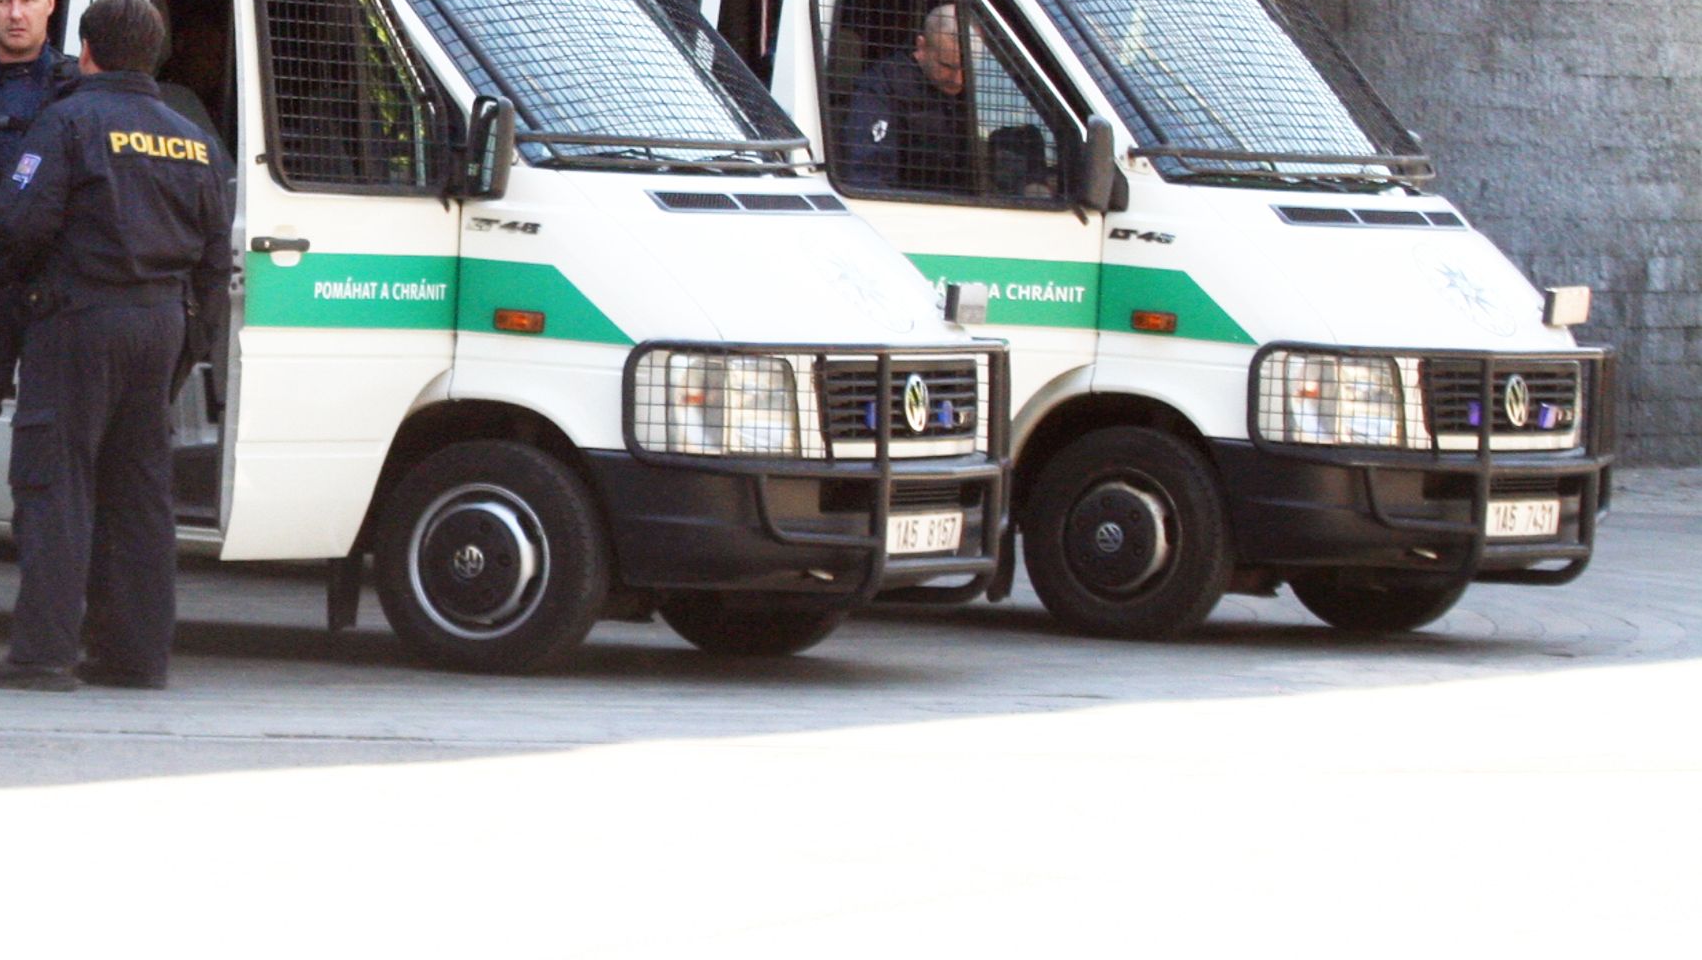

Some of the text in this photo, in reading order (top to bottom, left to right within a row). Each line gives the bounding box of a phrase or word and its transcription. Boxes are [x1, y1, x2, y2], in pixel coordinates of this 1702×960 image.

[110, 131, 210, 165] POLICIE
[313, 276, 447, 301] POMÁHAT A CHRÁNIT
[988, 283, 1000, 299] A
[1006, 281, 1086, 303] CHRÁNIT
[896, 519, 919, 549] 1A5
